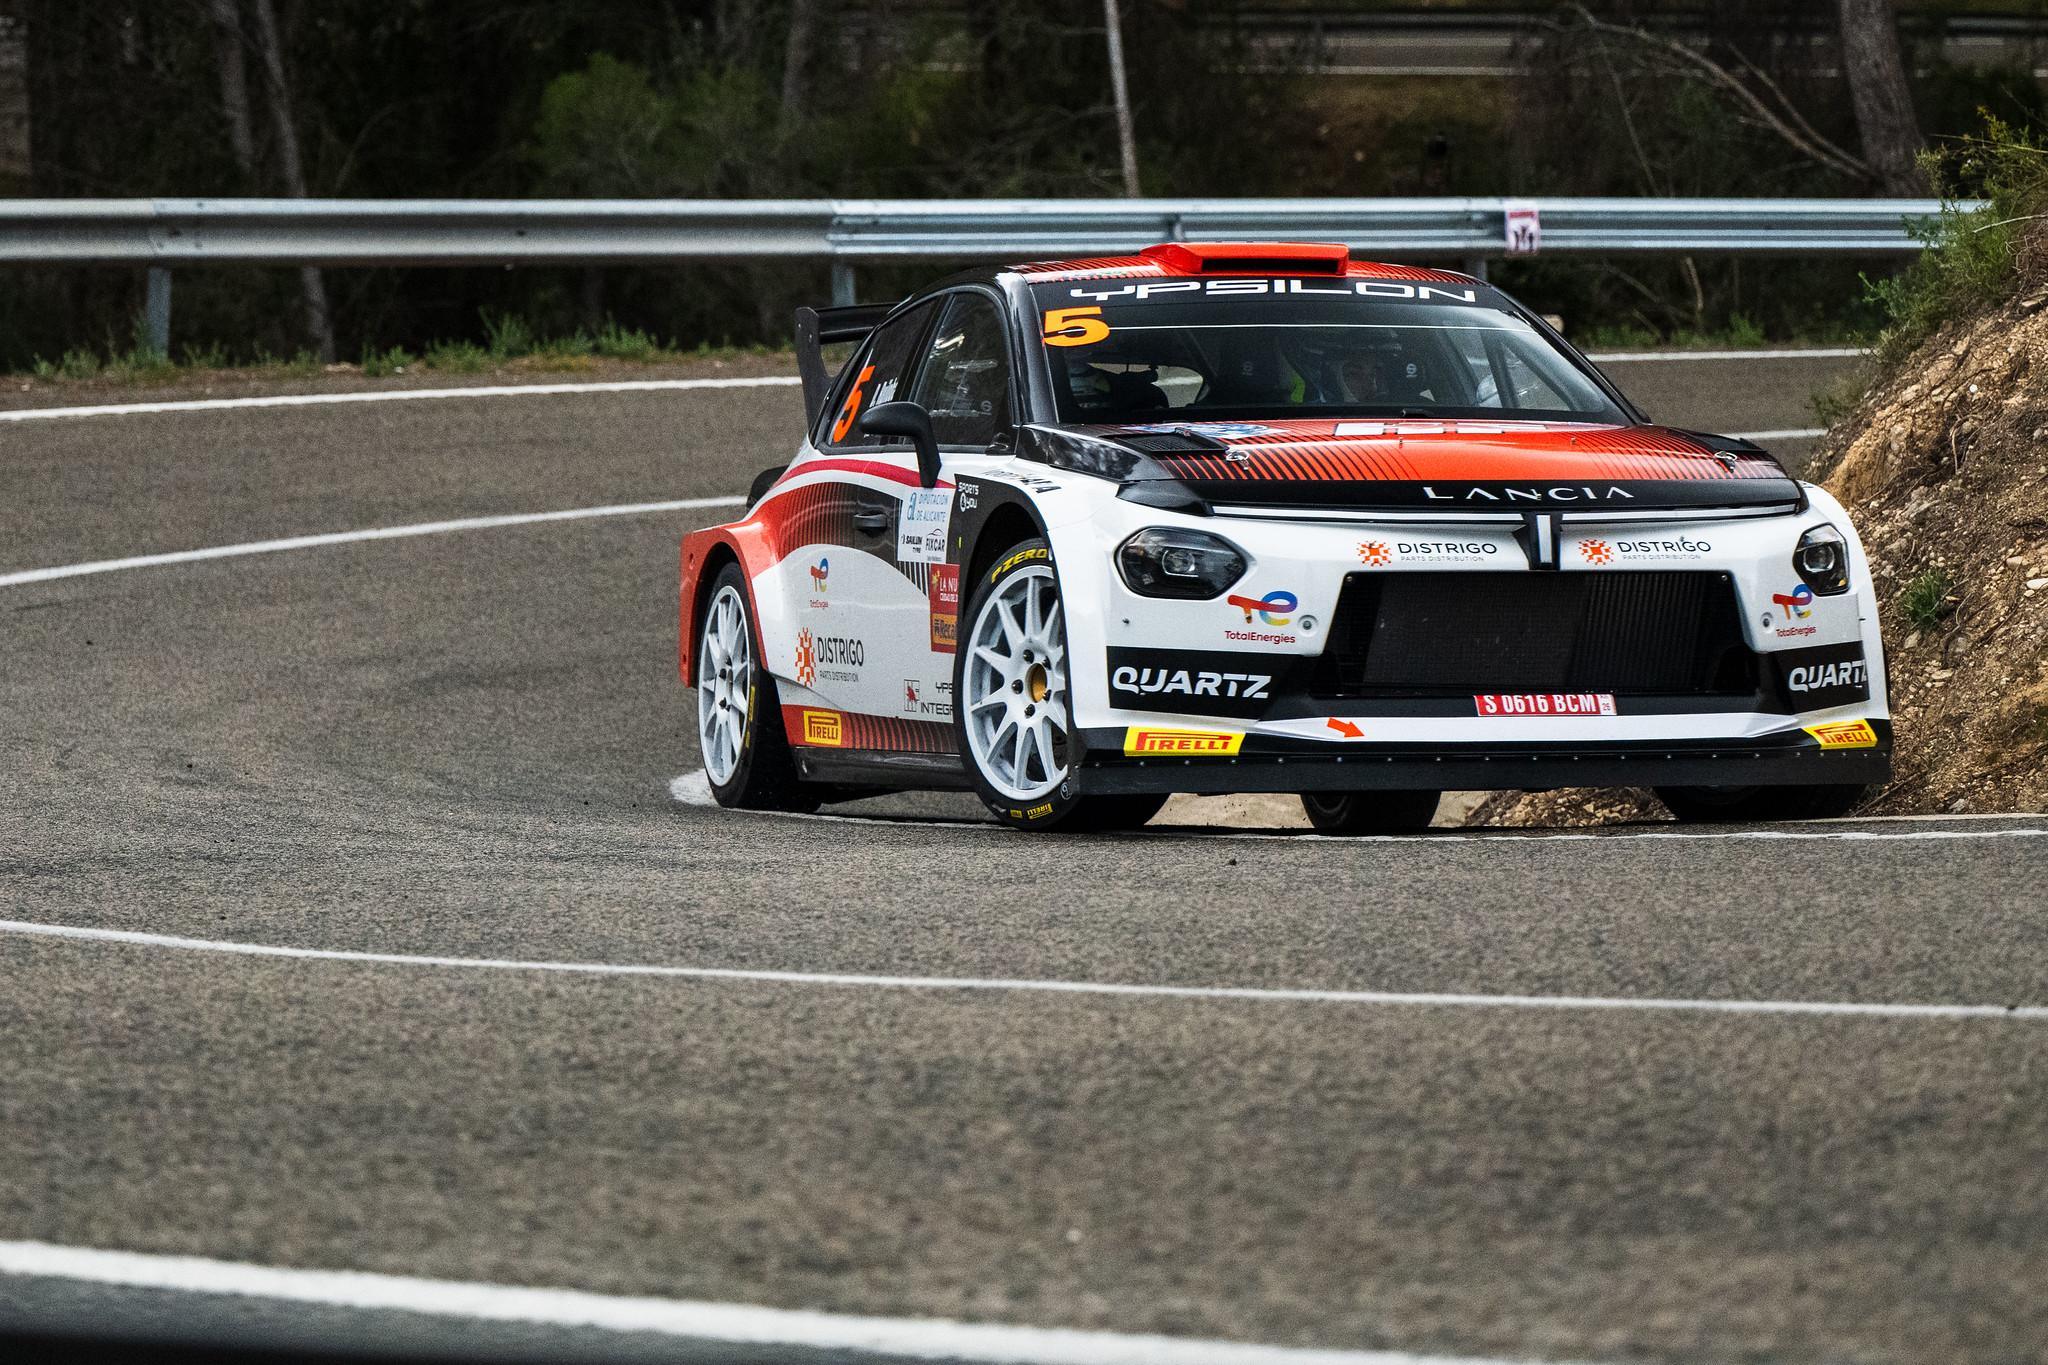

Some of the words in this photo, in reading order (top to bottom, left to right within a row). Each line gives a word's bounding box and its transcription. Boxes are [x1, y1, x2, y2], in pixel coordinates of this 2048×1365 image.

[1070, 279, 1476, 302] YPSILON
[1043, 306, 1110, 347] 5
[833, 365, 876, 443] 5
[958, 482, 979, 495] SPORTS
[1423, 486, 1634, 500] LANCIA
[925, 538, 945, 552] FIXCAR
[1398, 543, 1497, 554] DISTRIGO
[1617, 541, 1712, 553] DISTRIGO
[1224, 630, 1296, 645] TotalEnergies
[1776, 625, 1817, 637] TotalEnergies
[817, 637, 864, 667] DISTRIGO
[819, 671, 831, 680] PARTS
[1112, 666, 1272, 699] QUARTZ
[1482, 694, 1497, 713] S
[1501, 694, 1549, 713] 0616
[1552, 694, 1596, 713] BCM
[808, 715, 839, 740] PIRELLI
[1814, 723, 1872, 744] PIRELLI
[1135, 731, 1232, 751] PIRELLI
